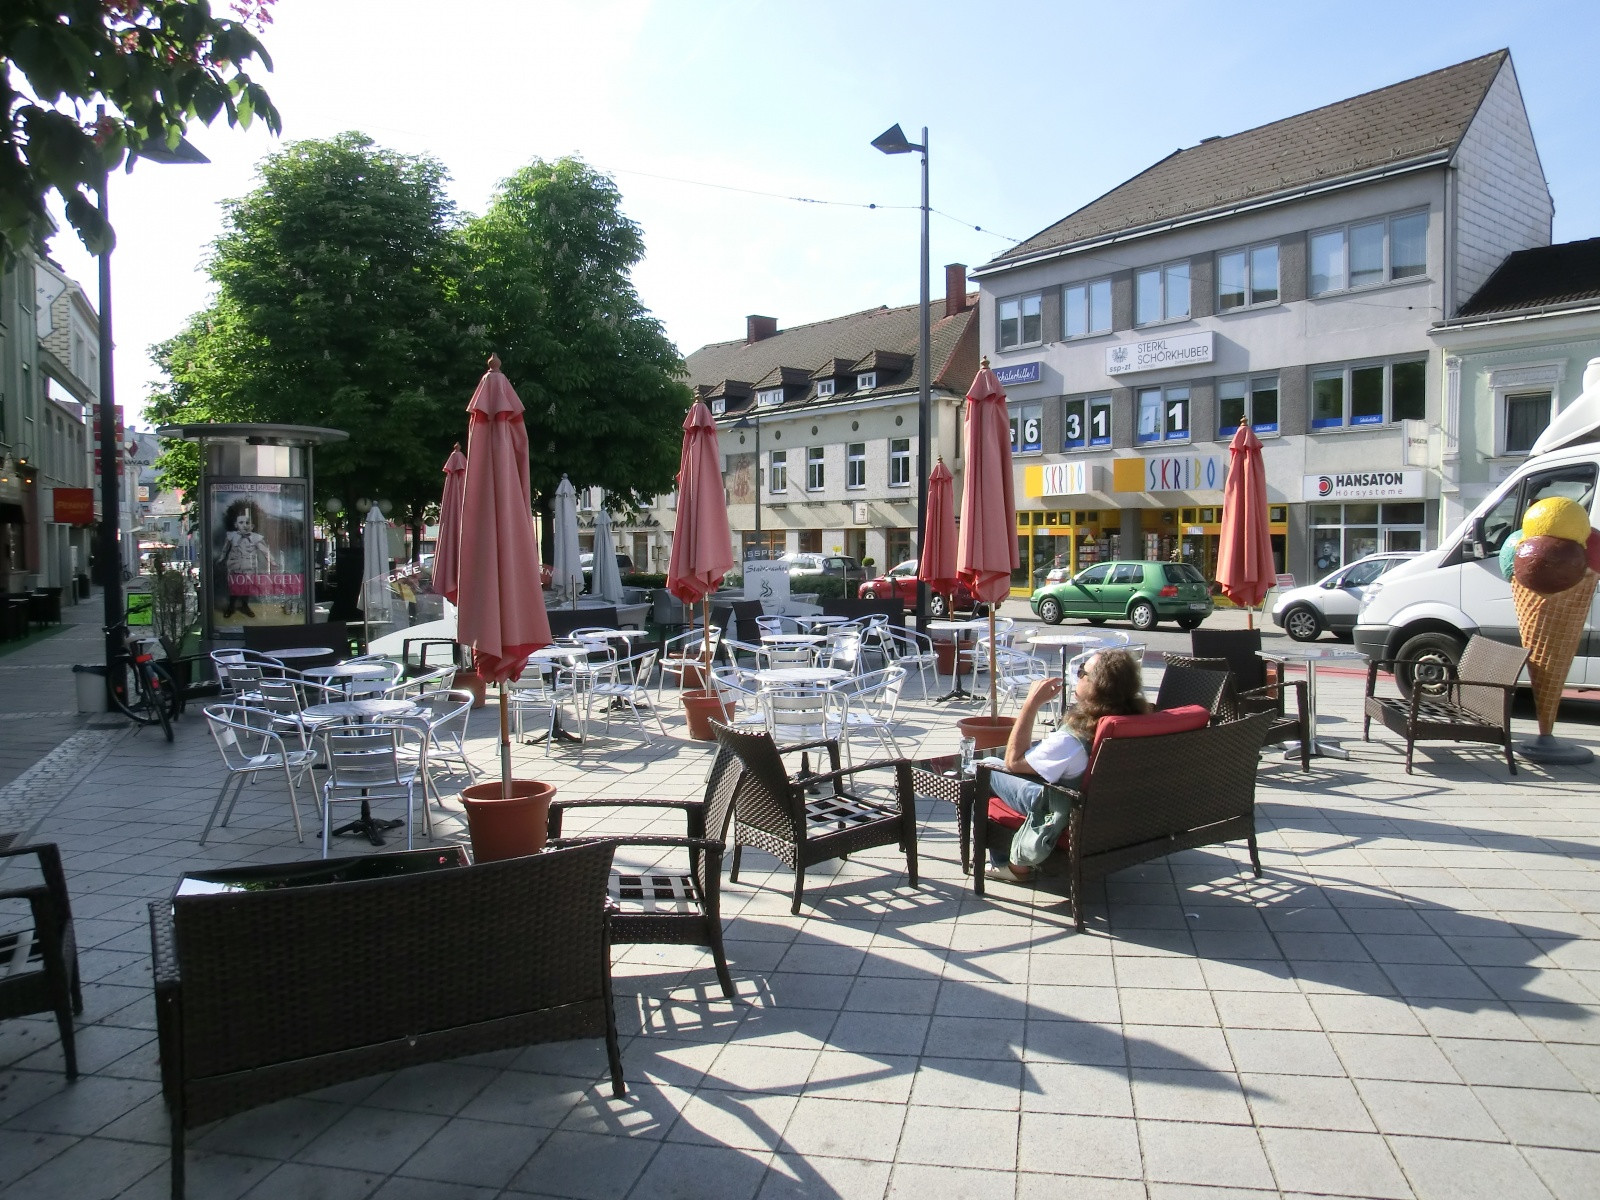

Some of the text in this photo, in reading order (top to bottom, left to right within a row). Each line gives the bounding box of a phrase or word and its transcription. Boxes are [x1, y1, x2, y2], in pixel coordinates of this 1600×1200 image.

[1137, 340, 1168, 354] STERKL
[1137, 345, 1209, 365] SCHÖRKHUBER
[1109, 363, 1131, 373] ssp-zt
[1024, 418, 1039, 443] 6
[1045, 463, 1083, 495] SKRIBO
[1150, 457, 1216, 490] SKRIBO
[1335, 472, 1404, 487] HANSATON
[1335, 488, 1403, 498] Hörsysteme
[228, 574, 302, 585] VON ENGELN
